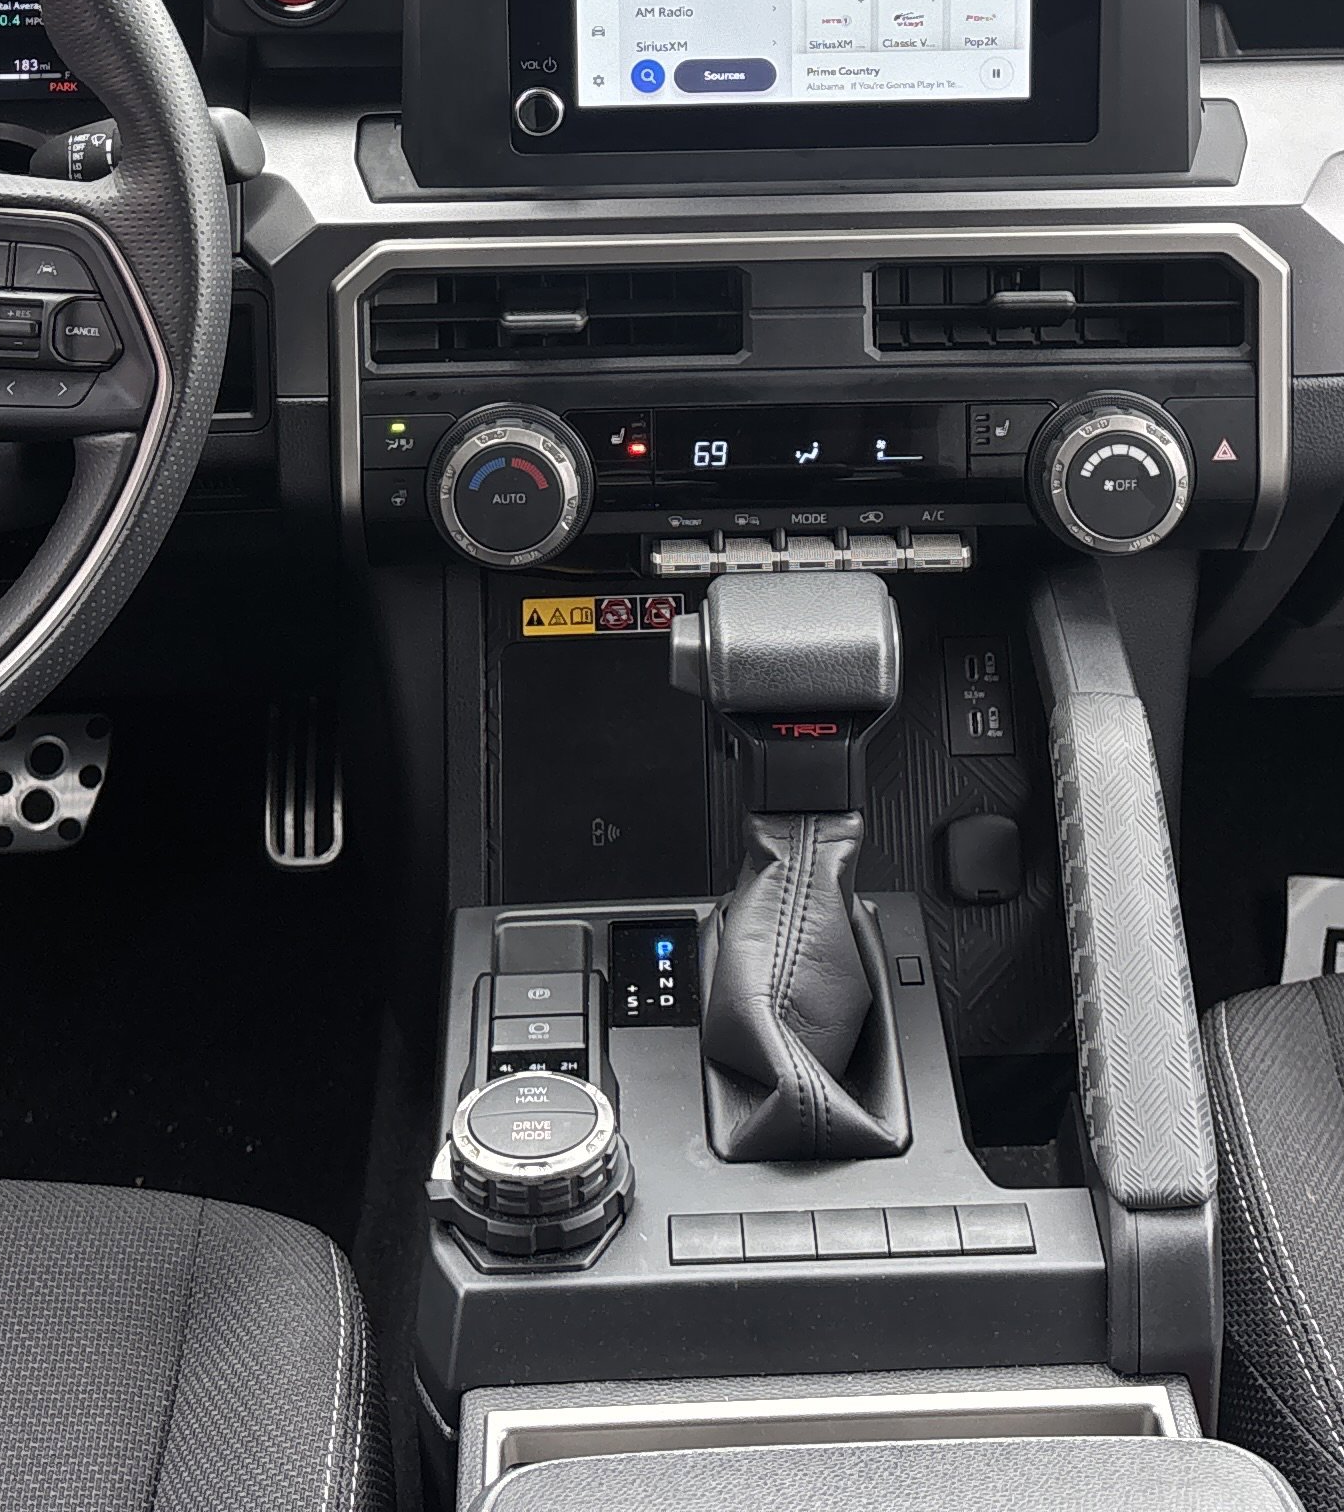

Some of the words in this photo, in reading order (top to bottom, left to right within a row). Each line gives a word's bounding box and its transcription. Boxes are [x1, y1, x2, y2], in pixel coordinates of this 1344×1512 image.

[634, 7, 655, 18] AM
[658, 6, 694, 18] Radio
[636, 41, 688, 53] SiriusXM
[808, 39, 853, 50] SiriusXM
[882, 38, 917, 48] Classic
[964, 36, 998, 49] Pop2K
[520, 60, 541, 70] VOL
[703, 70, 746, 81] Sources
[806, 67, 836, 77] Prime
[838, 66, 880, 78] Country
[49, 82, 78, 92] PARK
[65, 325, 100, 337] CANCEL
[693, 440, 728, 466] 69
[1115, 479, 1138, 491] OFF
[491, 492, 527, 505] AUTO
[791, 513, 828, 524] MODE
[922, 510, 946, 522] A/C
[772, 723, 838, 737] TRD
[657, 941, 673, 957] P
[658, 960, 673, 971] R
[659, 977, 674, 988] N
[627, 996, 639, 1008] S
[659, 995, 674, 1006] D
[528, 1062, 546, 1071] 4H
[560, 1061, 578, 1071] 2H
[517, 1087, 548, 1095] TOW
[515, 1095, 550, 1103] HAUL
[513, 1121, 552, 1130] DRIVE
[511, 1130, 552, 1141] MODE
